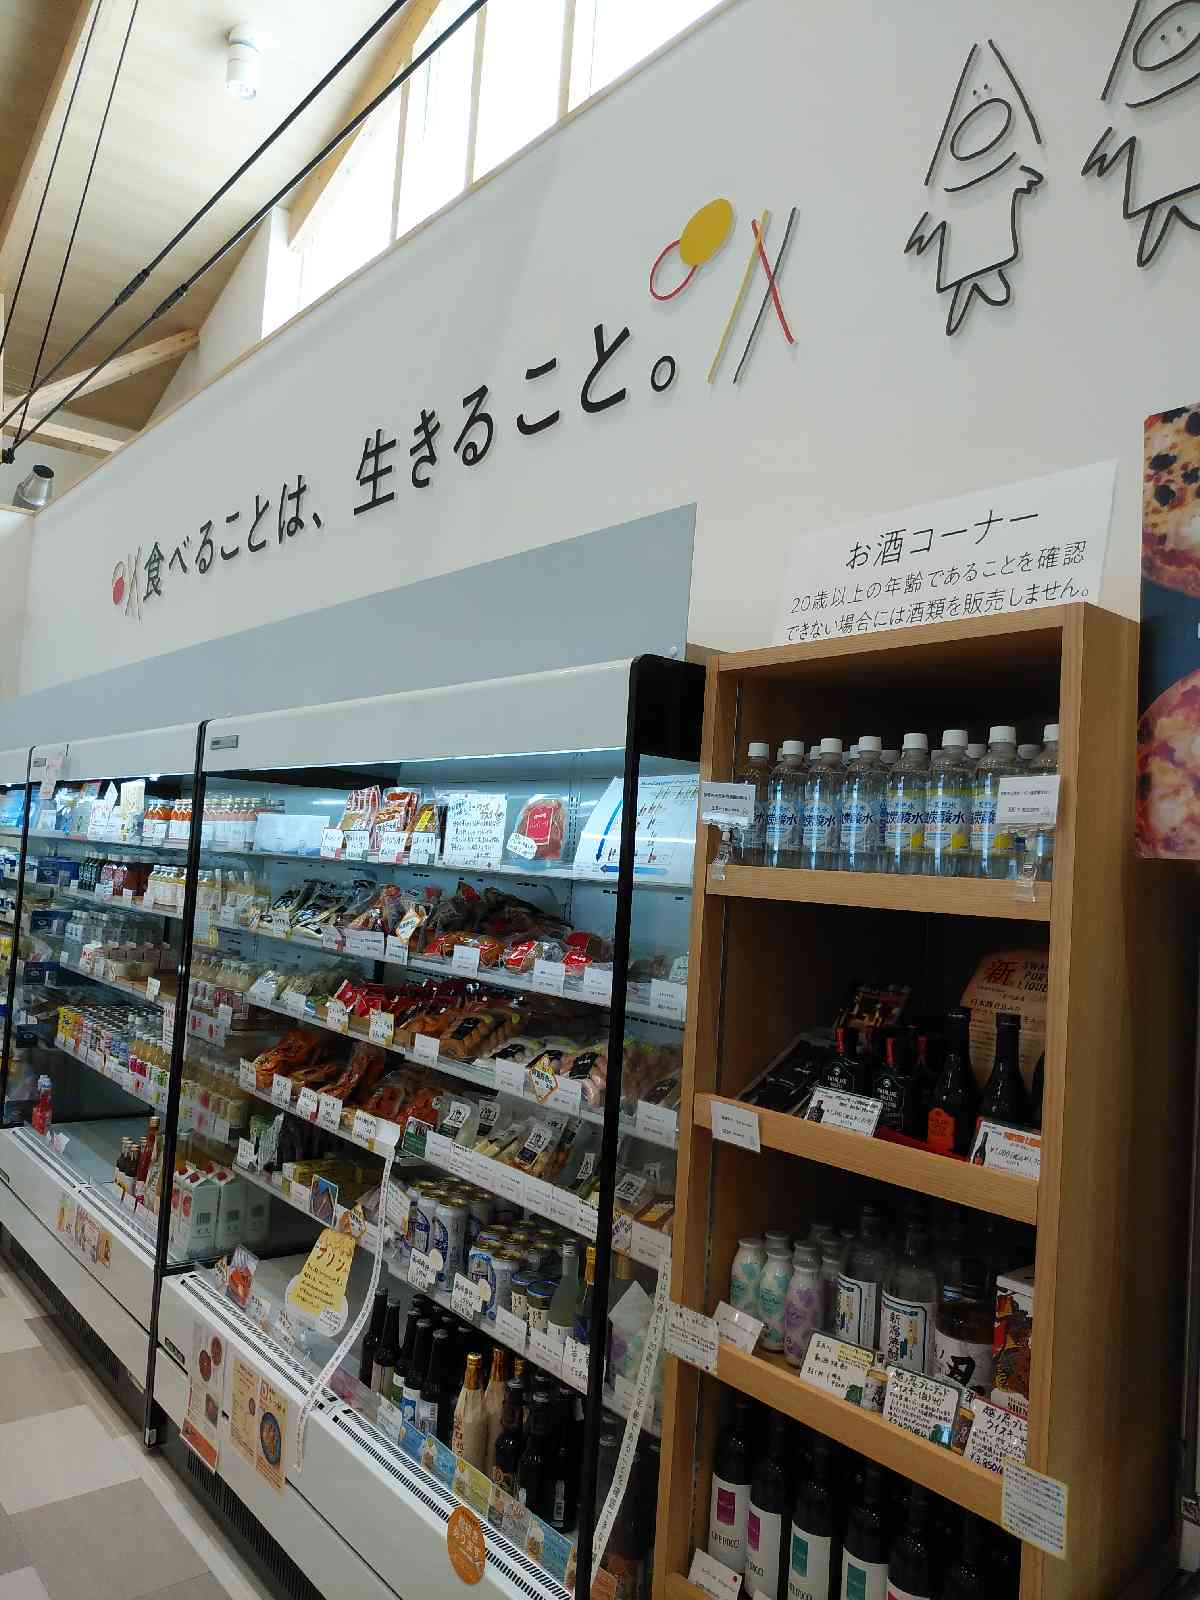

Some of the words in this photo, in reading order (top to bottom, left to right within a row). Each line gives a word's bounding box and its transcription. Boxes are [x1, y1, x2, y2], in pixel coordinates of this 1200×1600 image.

[845, 509, 1039, 570] お酒コーナー
[790, 540, 1088, 614] 20歳以上の年齢であることを確認
[785, 577, 1089, 641] できない場合には酒類を販売しません。
[926, 809, 966, 825] 炭酸水
